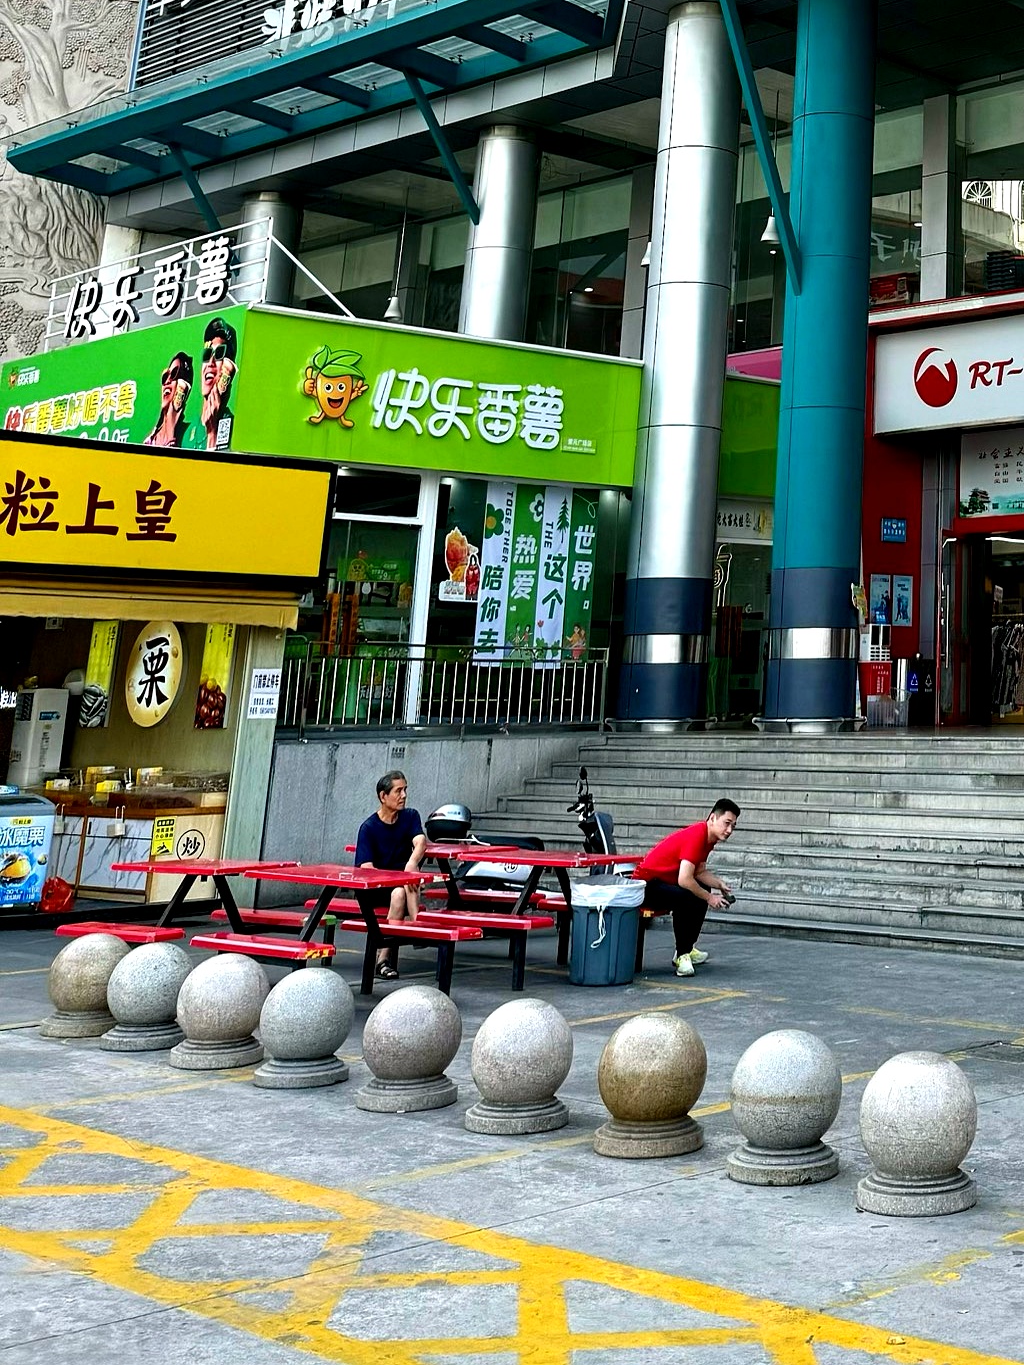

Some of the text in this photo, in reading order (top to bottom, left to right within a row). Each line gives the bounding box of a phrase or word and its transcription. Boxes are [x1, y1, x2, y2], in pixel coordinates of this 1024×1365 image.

[66, 236, 231, 338] 快乐番薯
[5, 380, 137, 434] 快乐番薯好喝不贵
[373, 367, 565, 450] 快乐番薯
[0, 469, 179, 543] 粒上皇
[543, 521, 554, 549] THE
[475, 565, 505, 655] 陪你去
[541, 553, 567, 621] 这个
[136, 636, 169, 708] 栗
[182, 836, 201, 856] 炒
